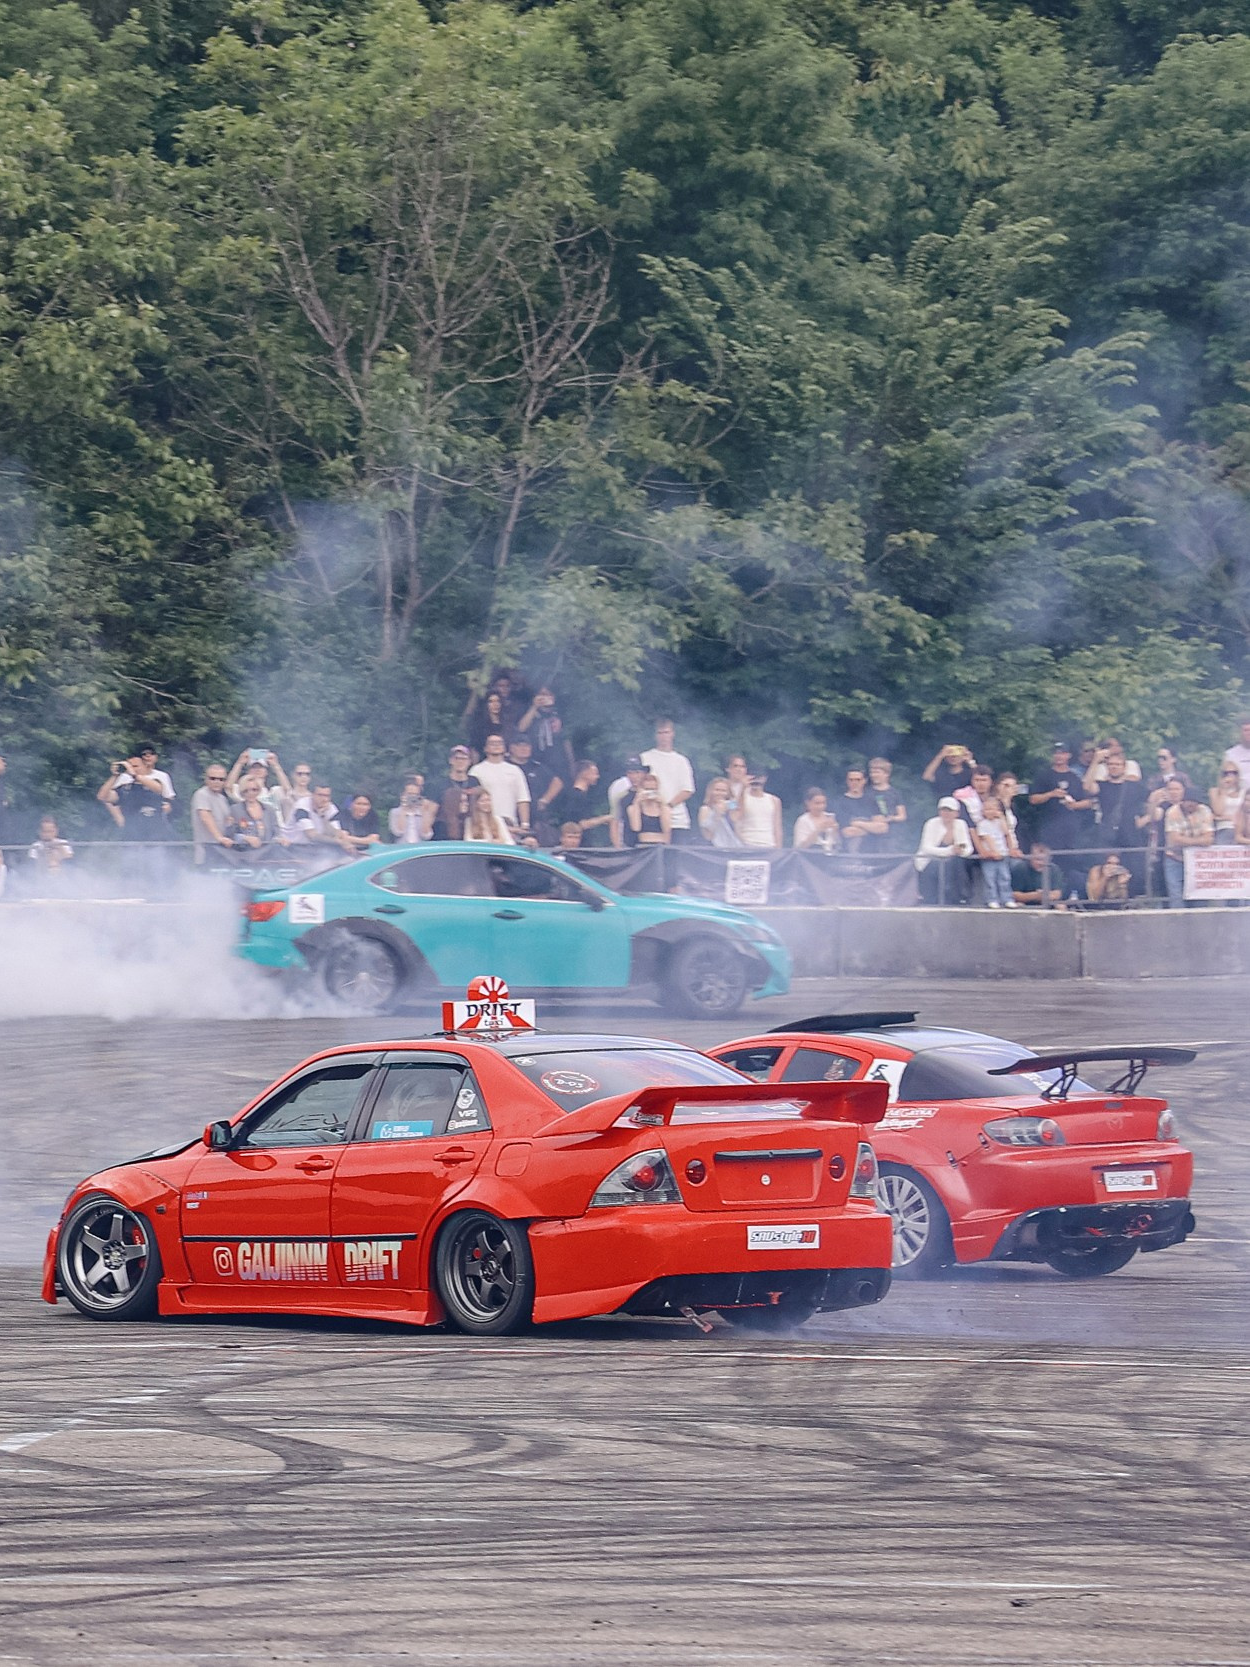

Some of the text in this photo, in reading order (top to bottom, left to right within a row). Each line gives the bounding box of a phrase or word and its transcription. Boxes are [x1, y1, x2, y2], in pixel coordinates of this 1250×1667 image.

[466, 1003, 521, 1017] DRIFT
[484, 1018, 503, 1026] taxi
[344, 1241, 402, 1281] DRIFT
